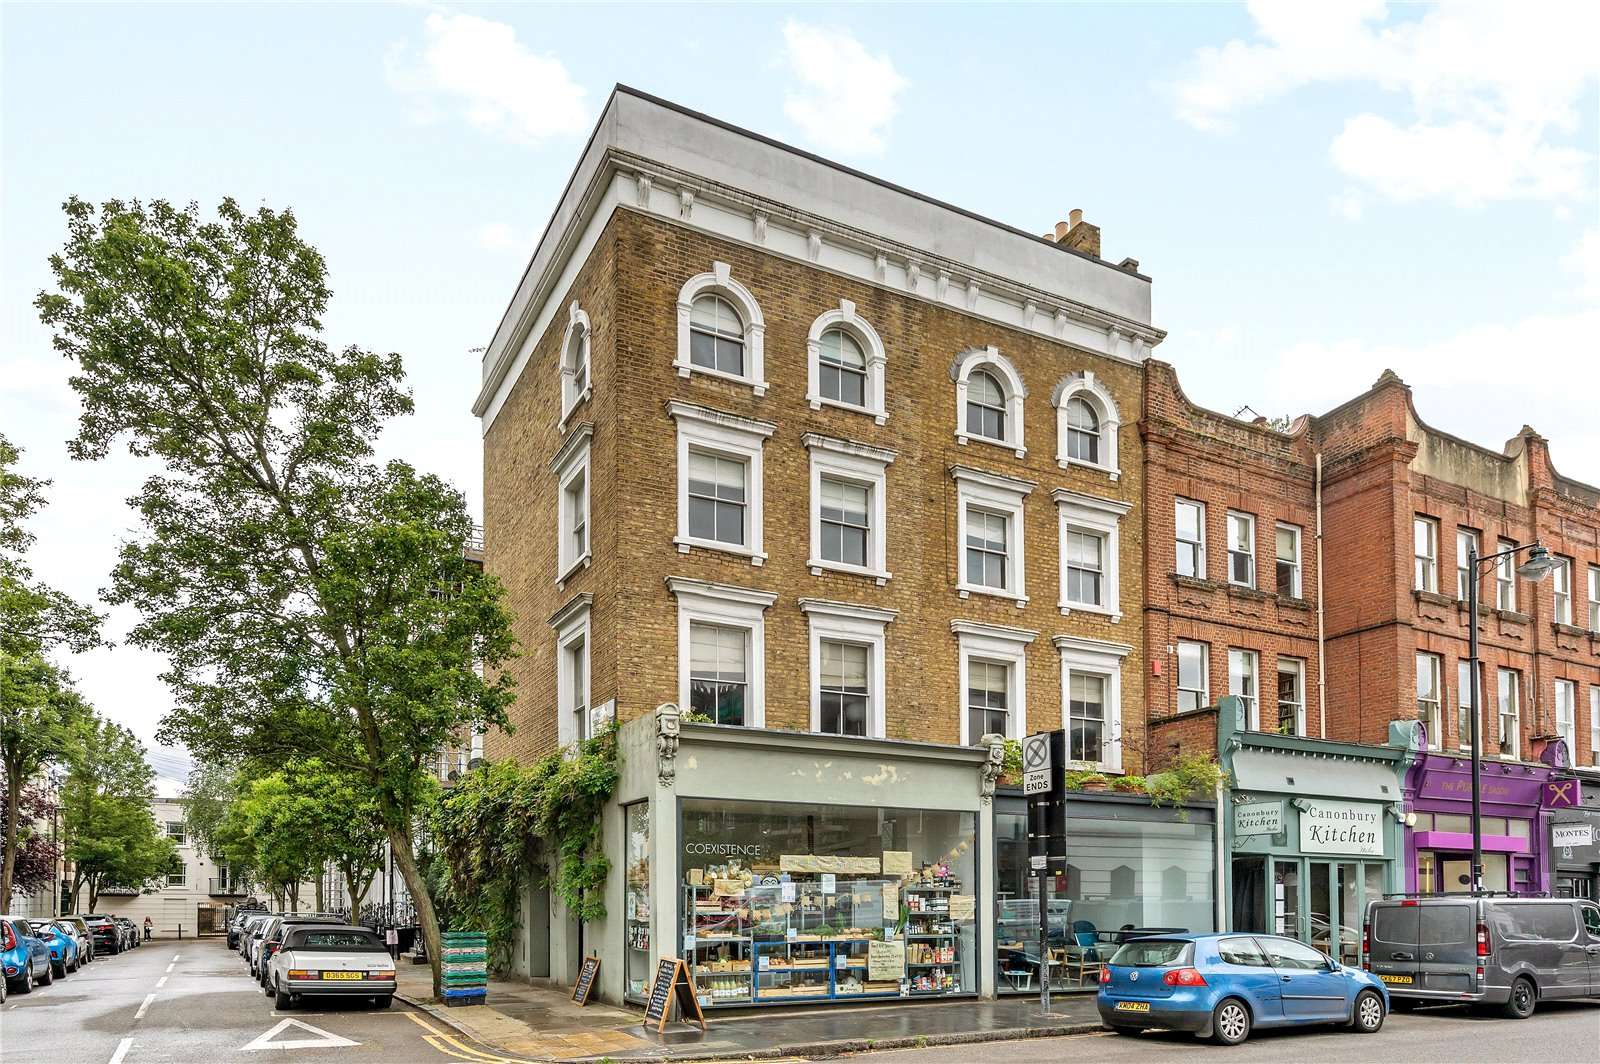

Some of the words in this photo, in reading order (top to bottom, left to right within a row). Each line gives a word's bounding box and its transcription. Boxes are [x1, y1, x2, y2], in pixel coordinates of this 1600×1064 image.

[1026, 781, 1048, 791] ENDS
[1237, 810, 1278, 818] Canonbury
[1309, 807, 1376, 824] Canonbury
[1238, 816, 1278, 829] Kitchen
[1309, 825, 1375, 844] Kitchen
[1556, 830, 1590, 838] MONTES
[686, 843, 761, 856] COEXISTENCE
